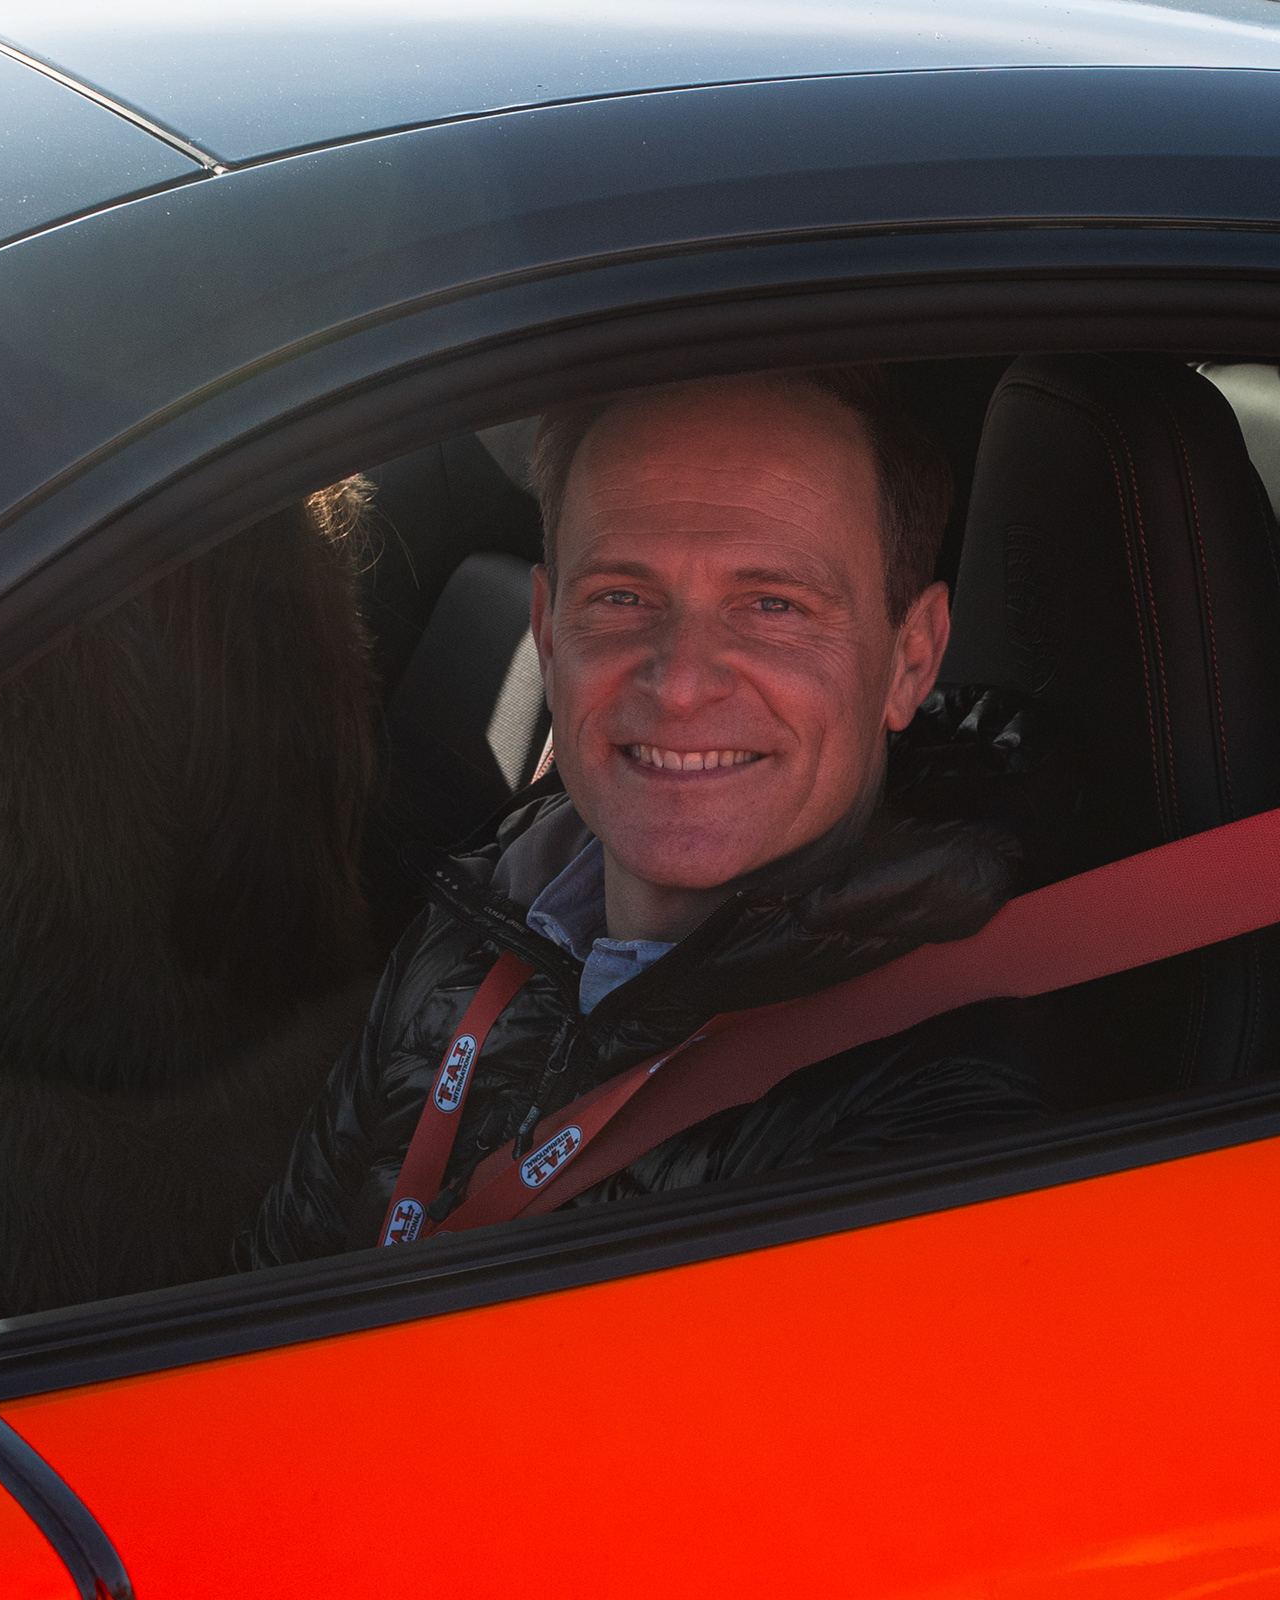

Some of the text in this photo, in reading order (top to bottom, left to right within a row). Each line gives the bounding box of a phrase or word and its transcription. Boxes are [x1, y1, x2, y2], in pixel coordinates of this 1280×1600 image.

[452, 1047, 474, 1104] INTERNATIONAL
[524, 1130, 571, 1169] INTERNATIONAL
[407, 1211, 423, 1241] ATIONAL
